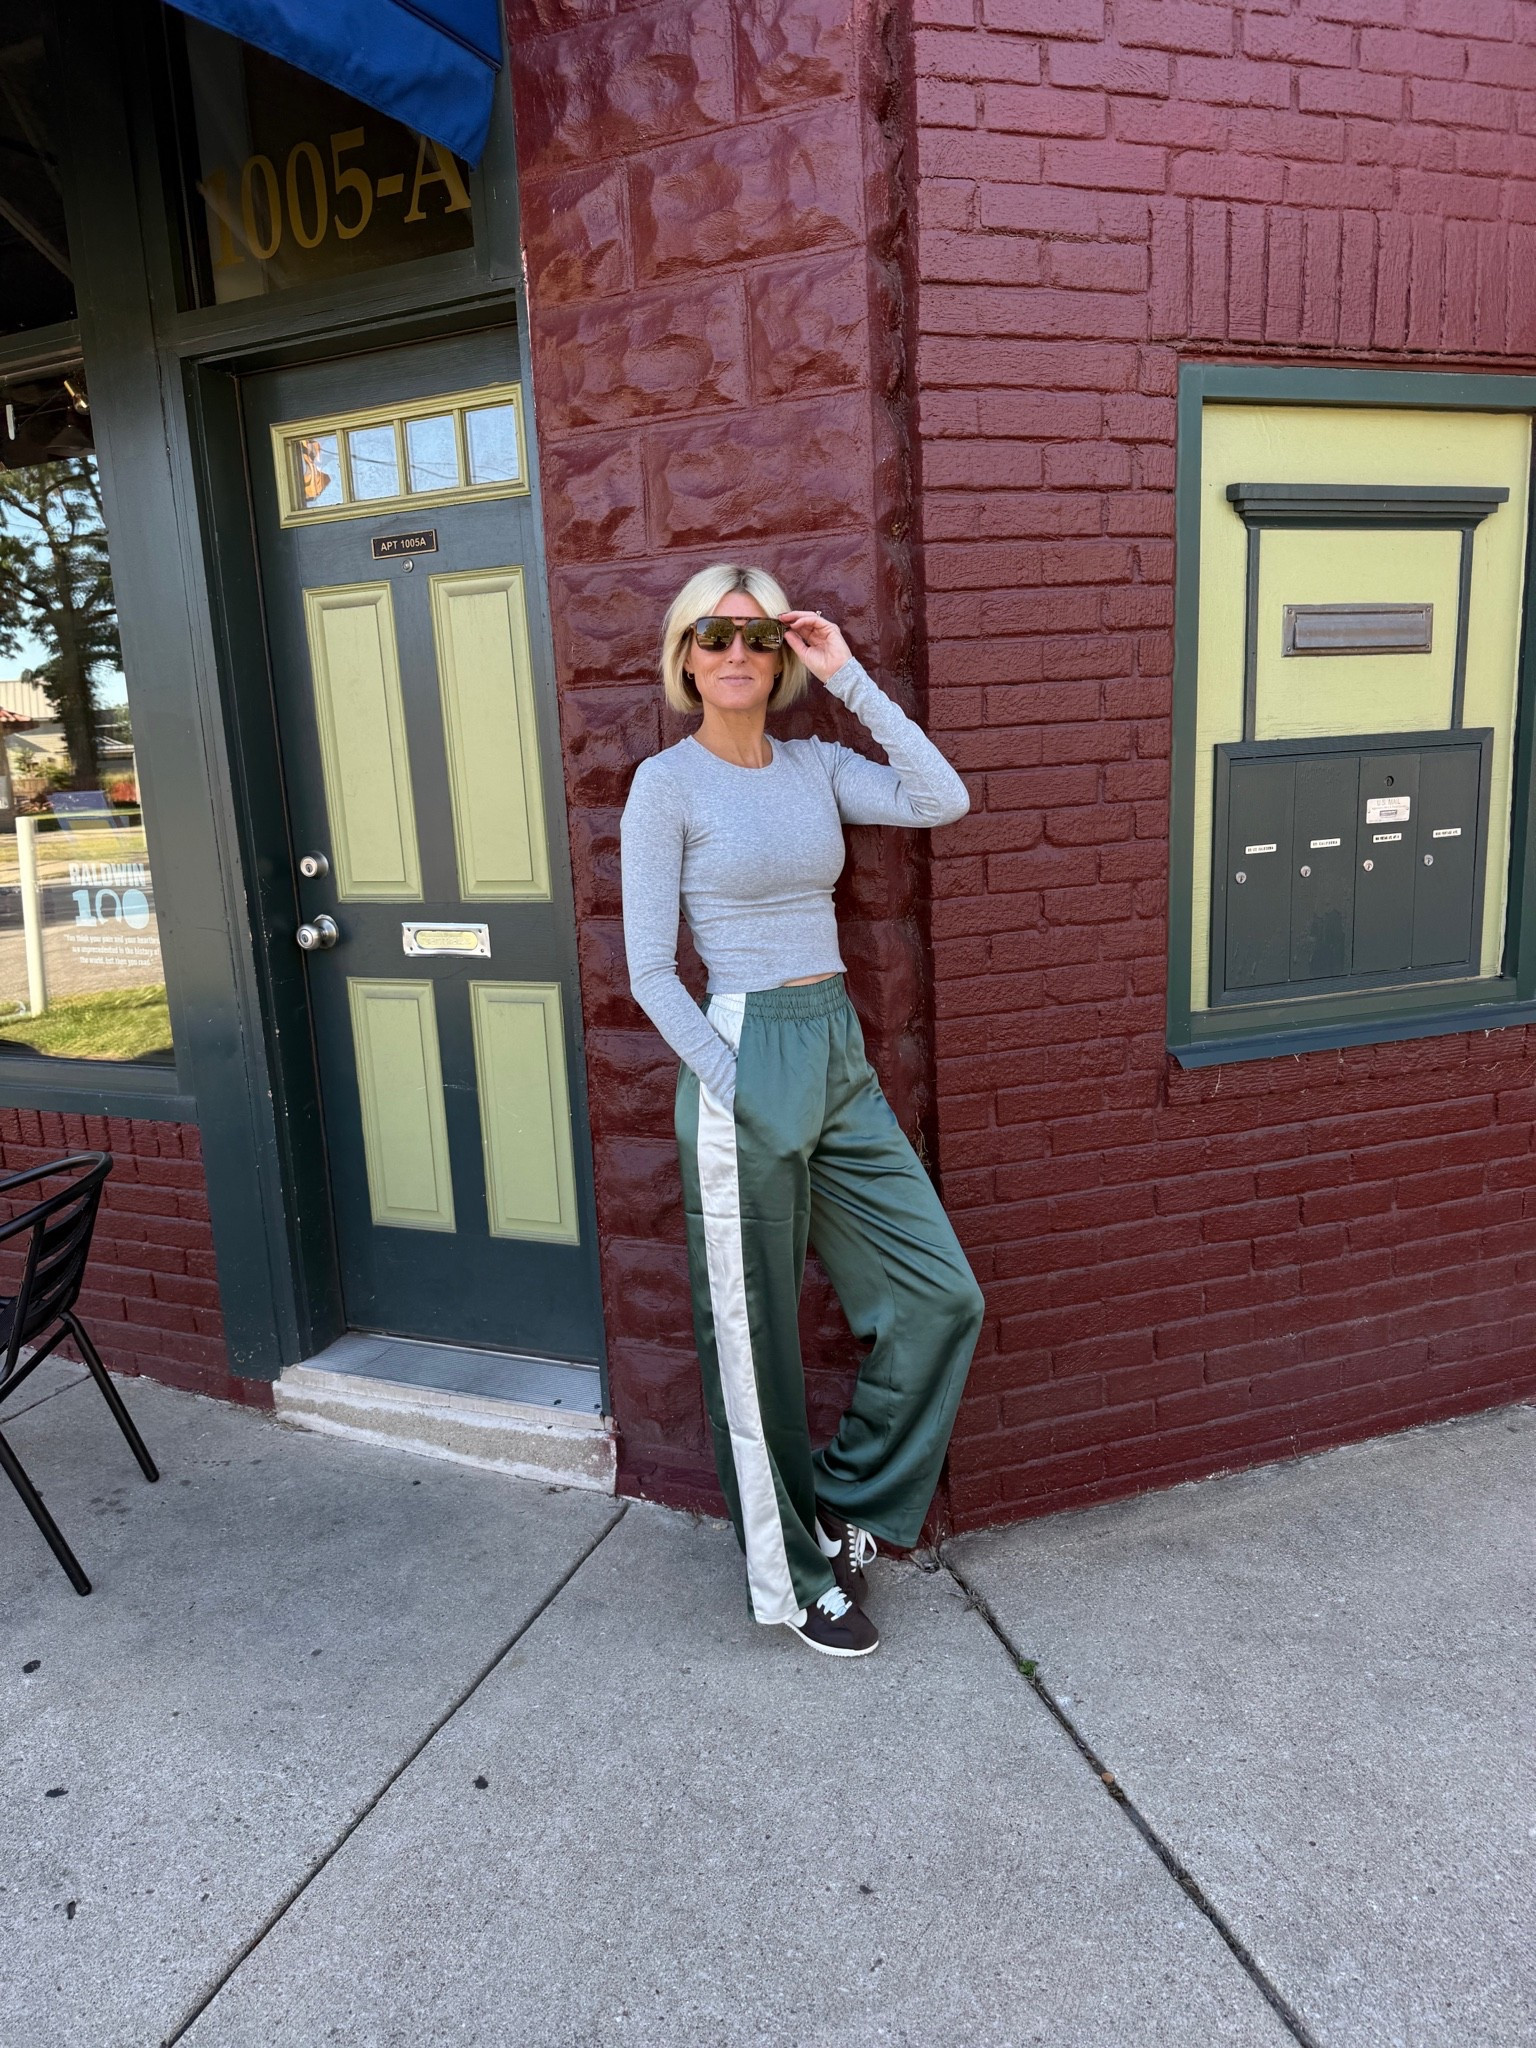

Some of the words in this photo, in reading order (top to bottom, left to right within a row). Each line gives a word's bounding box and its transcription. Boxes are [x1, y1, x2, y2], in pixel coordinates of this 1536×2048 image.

[202, 127, 471, 269] 1005-A
[380, 540, 398, 552] APT
[400, 537, 427, 549] 1005A
[68, 863, 147, 887] BALDWIN
